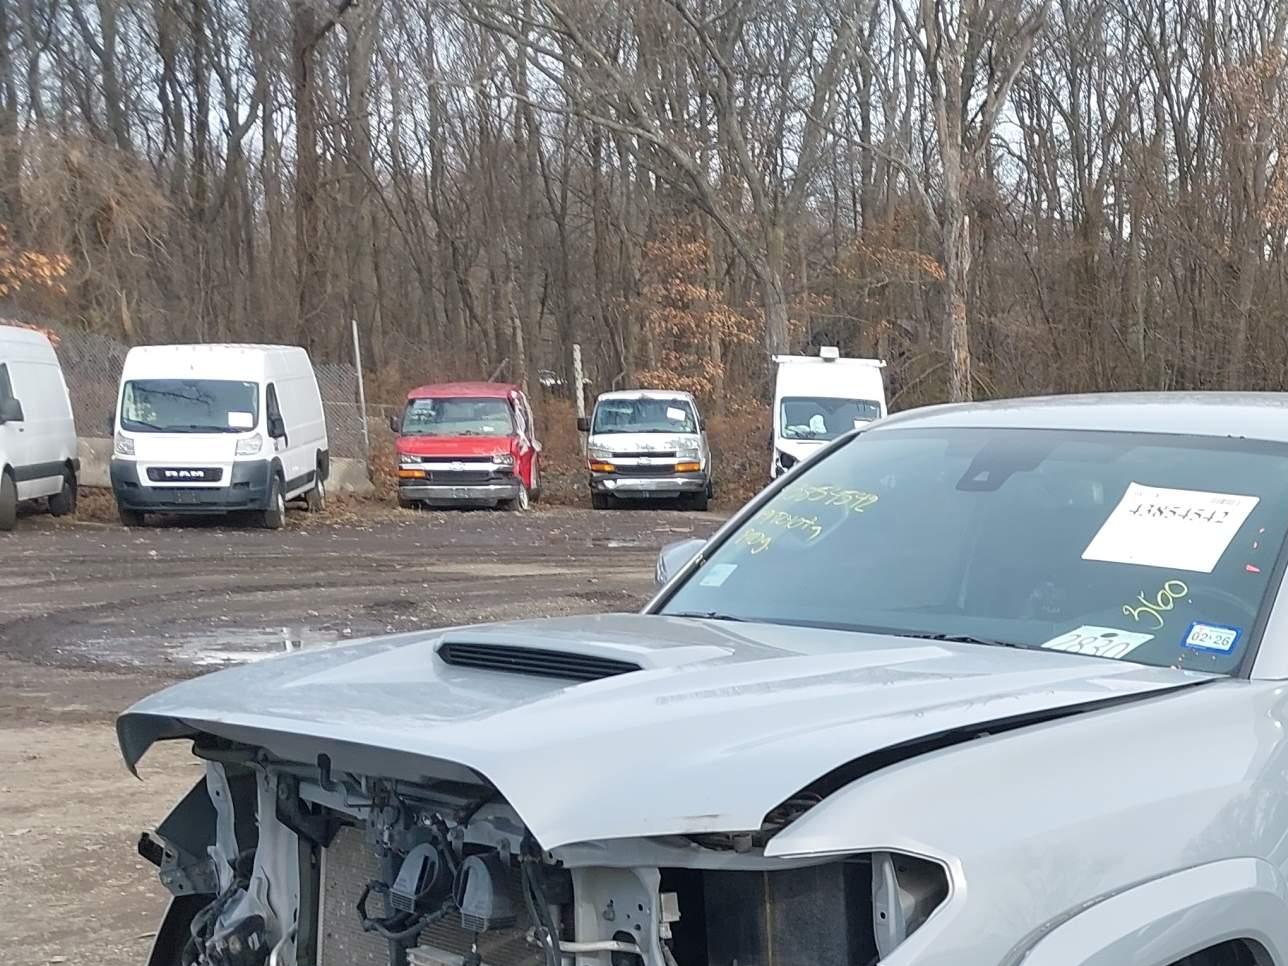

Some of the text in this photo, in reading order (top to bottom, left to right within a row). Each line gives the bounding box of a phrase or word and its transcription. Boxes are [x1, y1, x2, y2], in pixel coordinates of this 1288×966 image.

[165, 470, 205, 478] RAM
[1129, 502, 1230, 524] 43854542
[1191, 631, 1231, 647] 02 26
